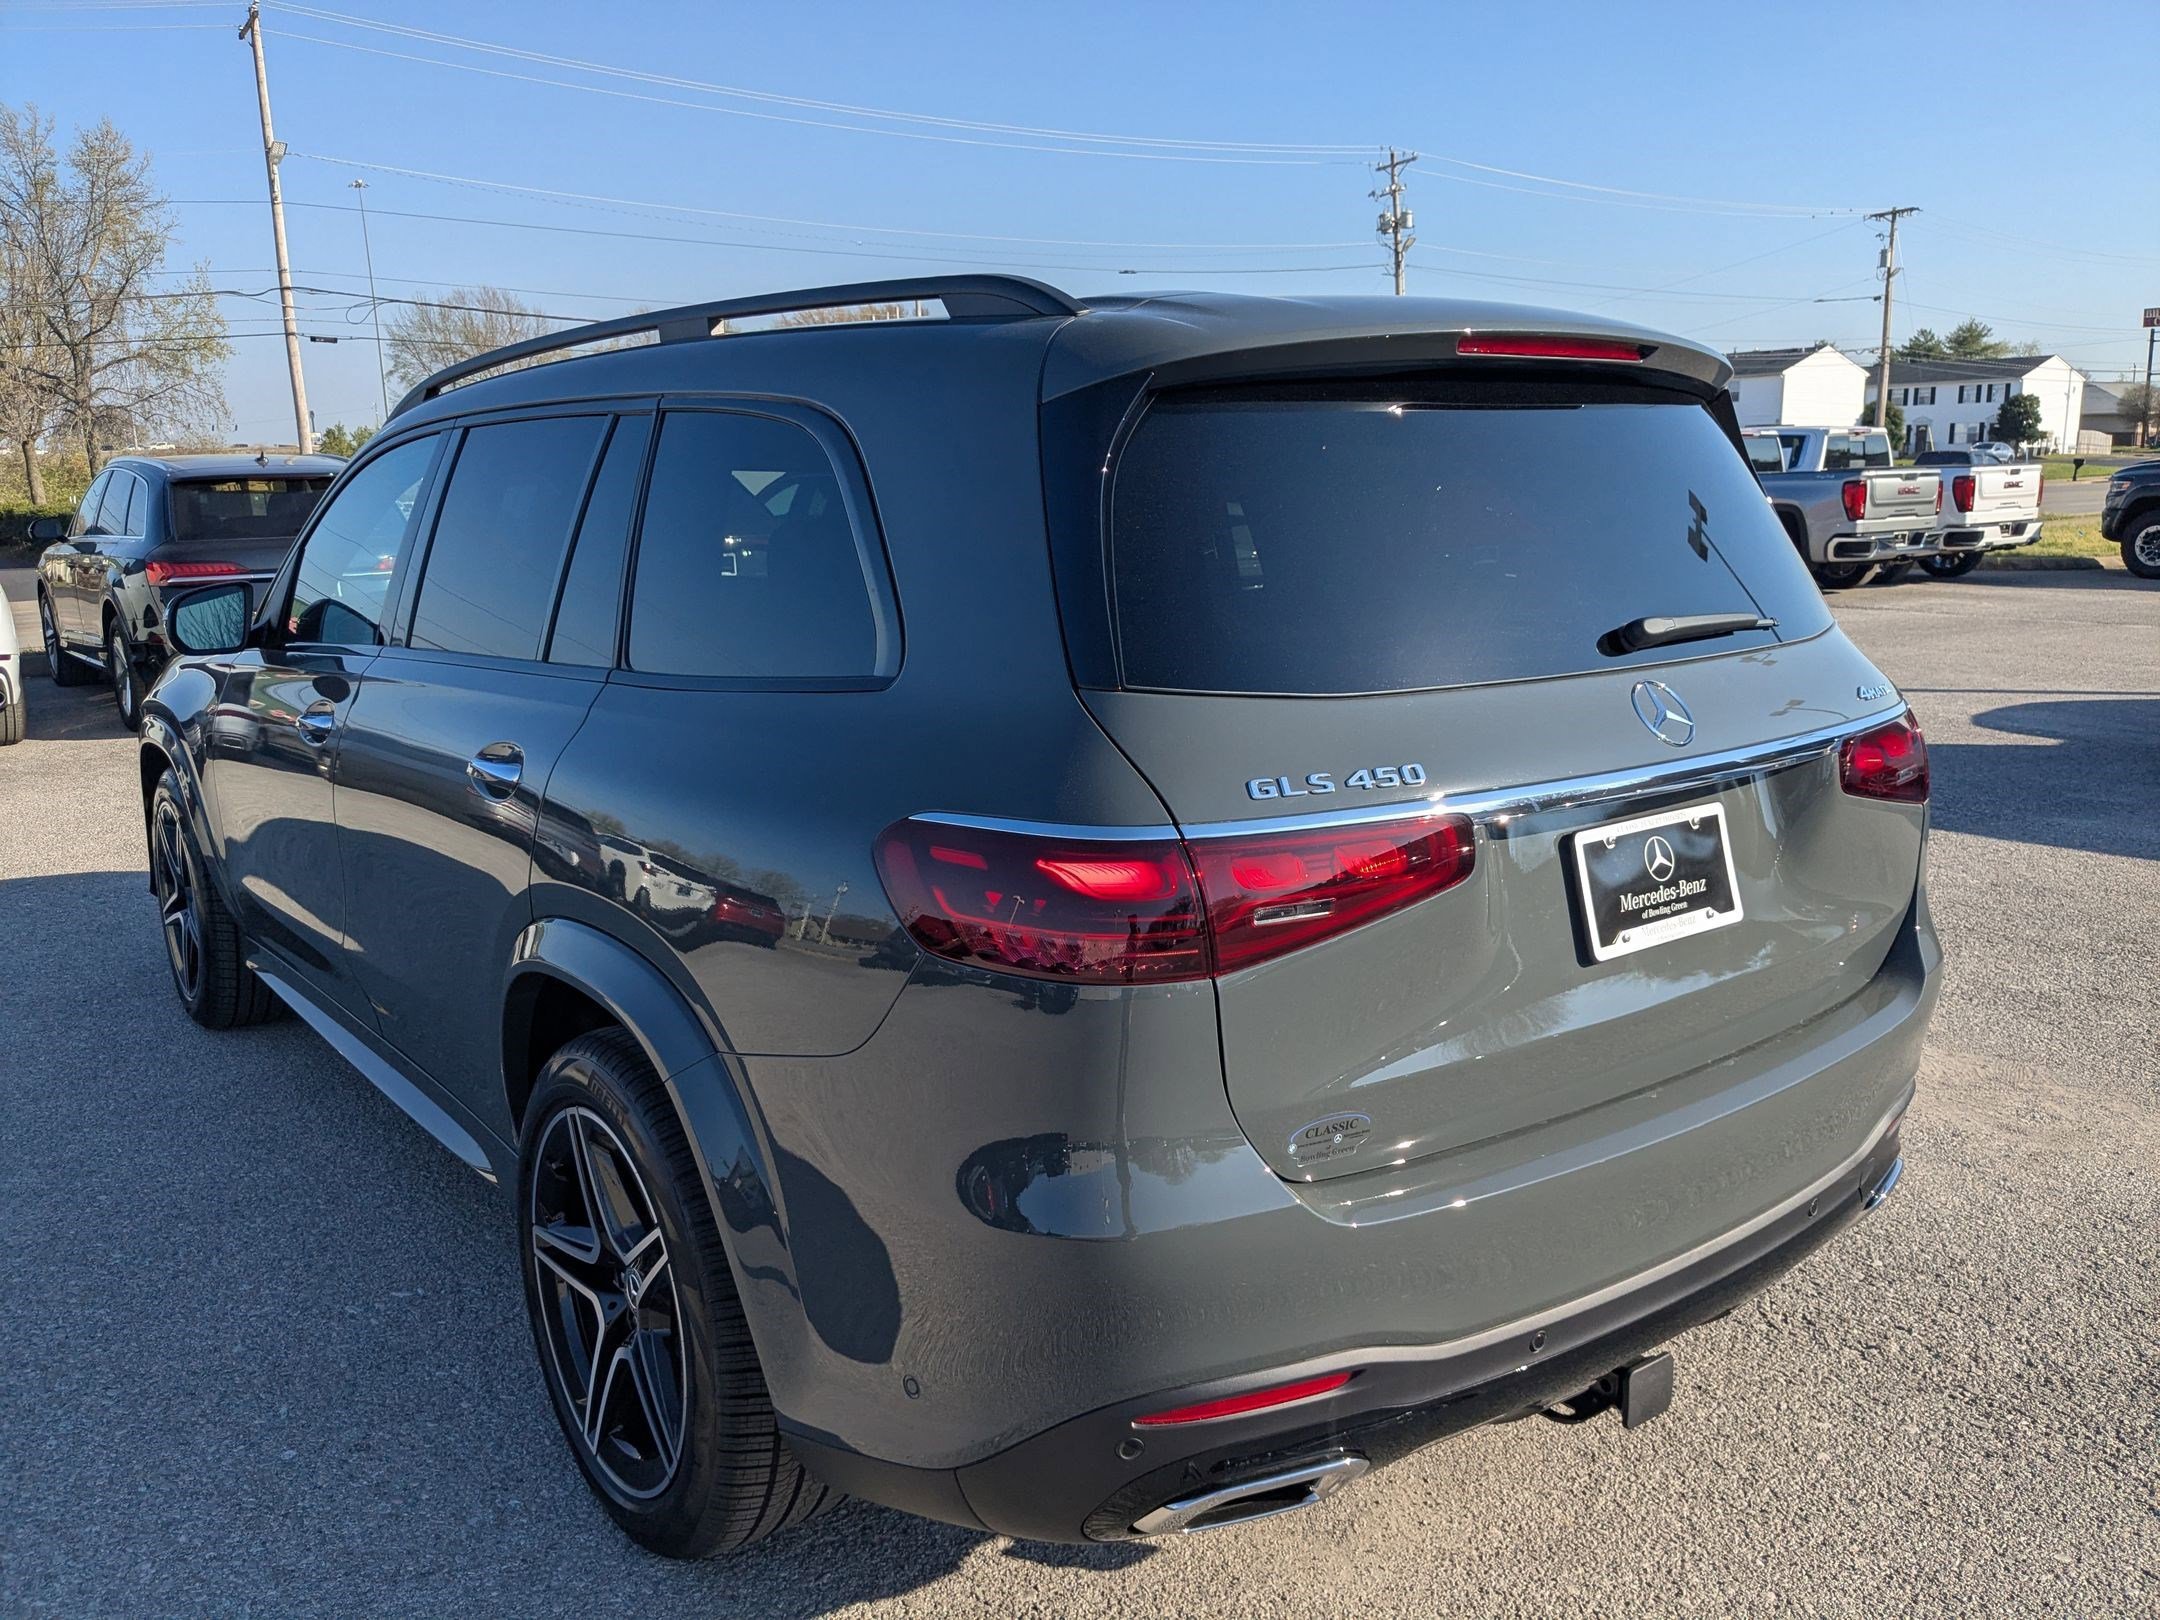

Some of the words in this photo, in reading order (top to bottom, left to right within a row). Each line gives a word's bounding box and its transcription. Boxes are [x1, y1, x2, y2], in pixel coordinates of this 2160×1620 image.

[1898, 486, 1921, 495] GMC
[2004, 480, 2024, 489] GMC
[1246, 772, 1335, 801] GLS
[1344, 763, 1426, 790] 450
[1620, 878, 1707, 913] Mercedes-Benz
[1641, 909, 1649, 919] of
[1649, 904, 1671, 918] Bowling
[1671, 901, 1688, 912] Green
[1305, 1118, 1359, 1139] CLASSIC
[1299, 1150, 1331, 1163] Bowling
[1331, 1145, 1355, 1156] Green
